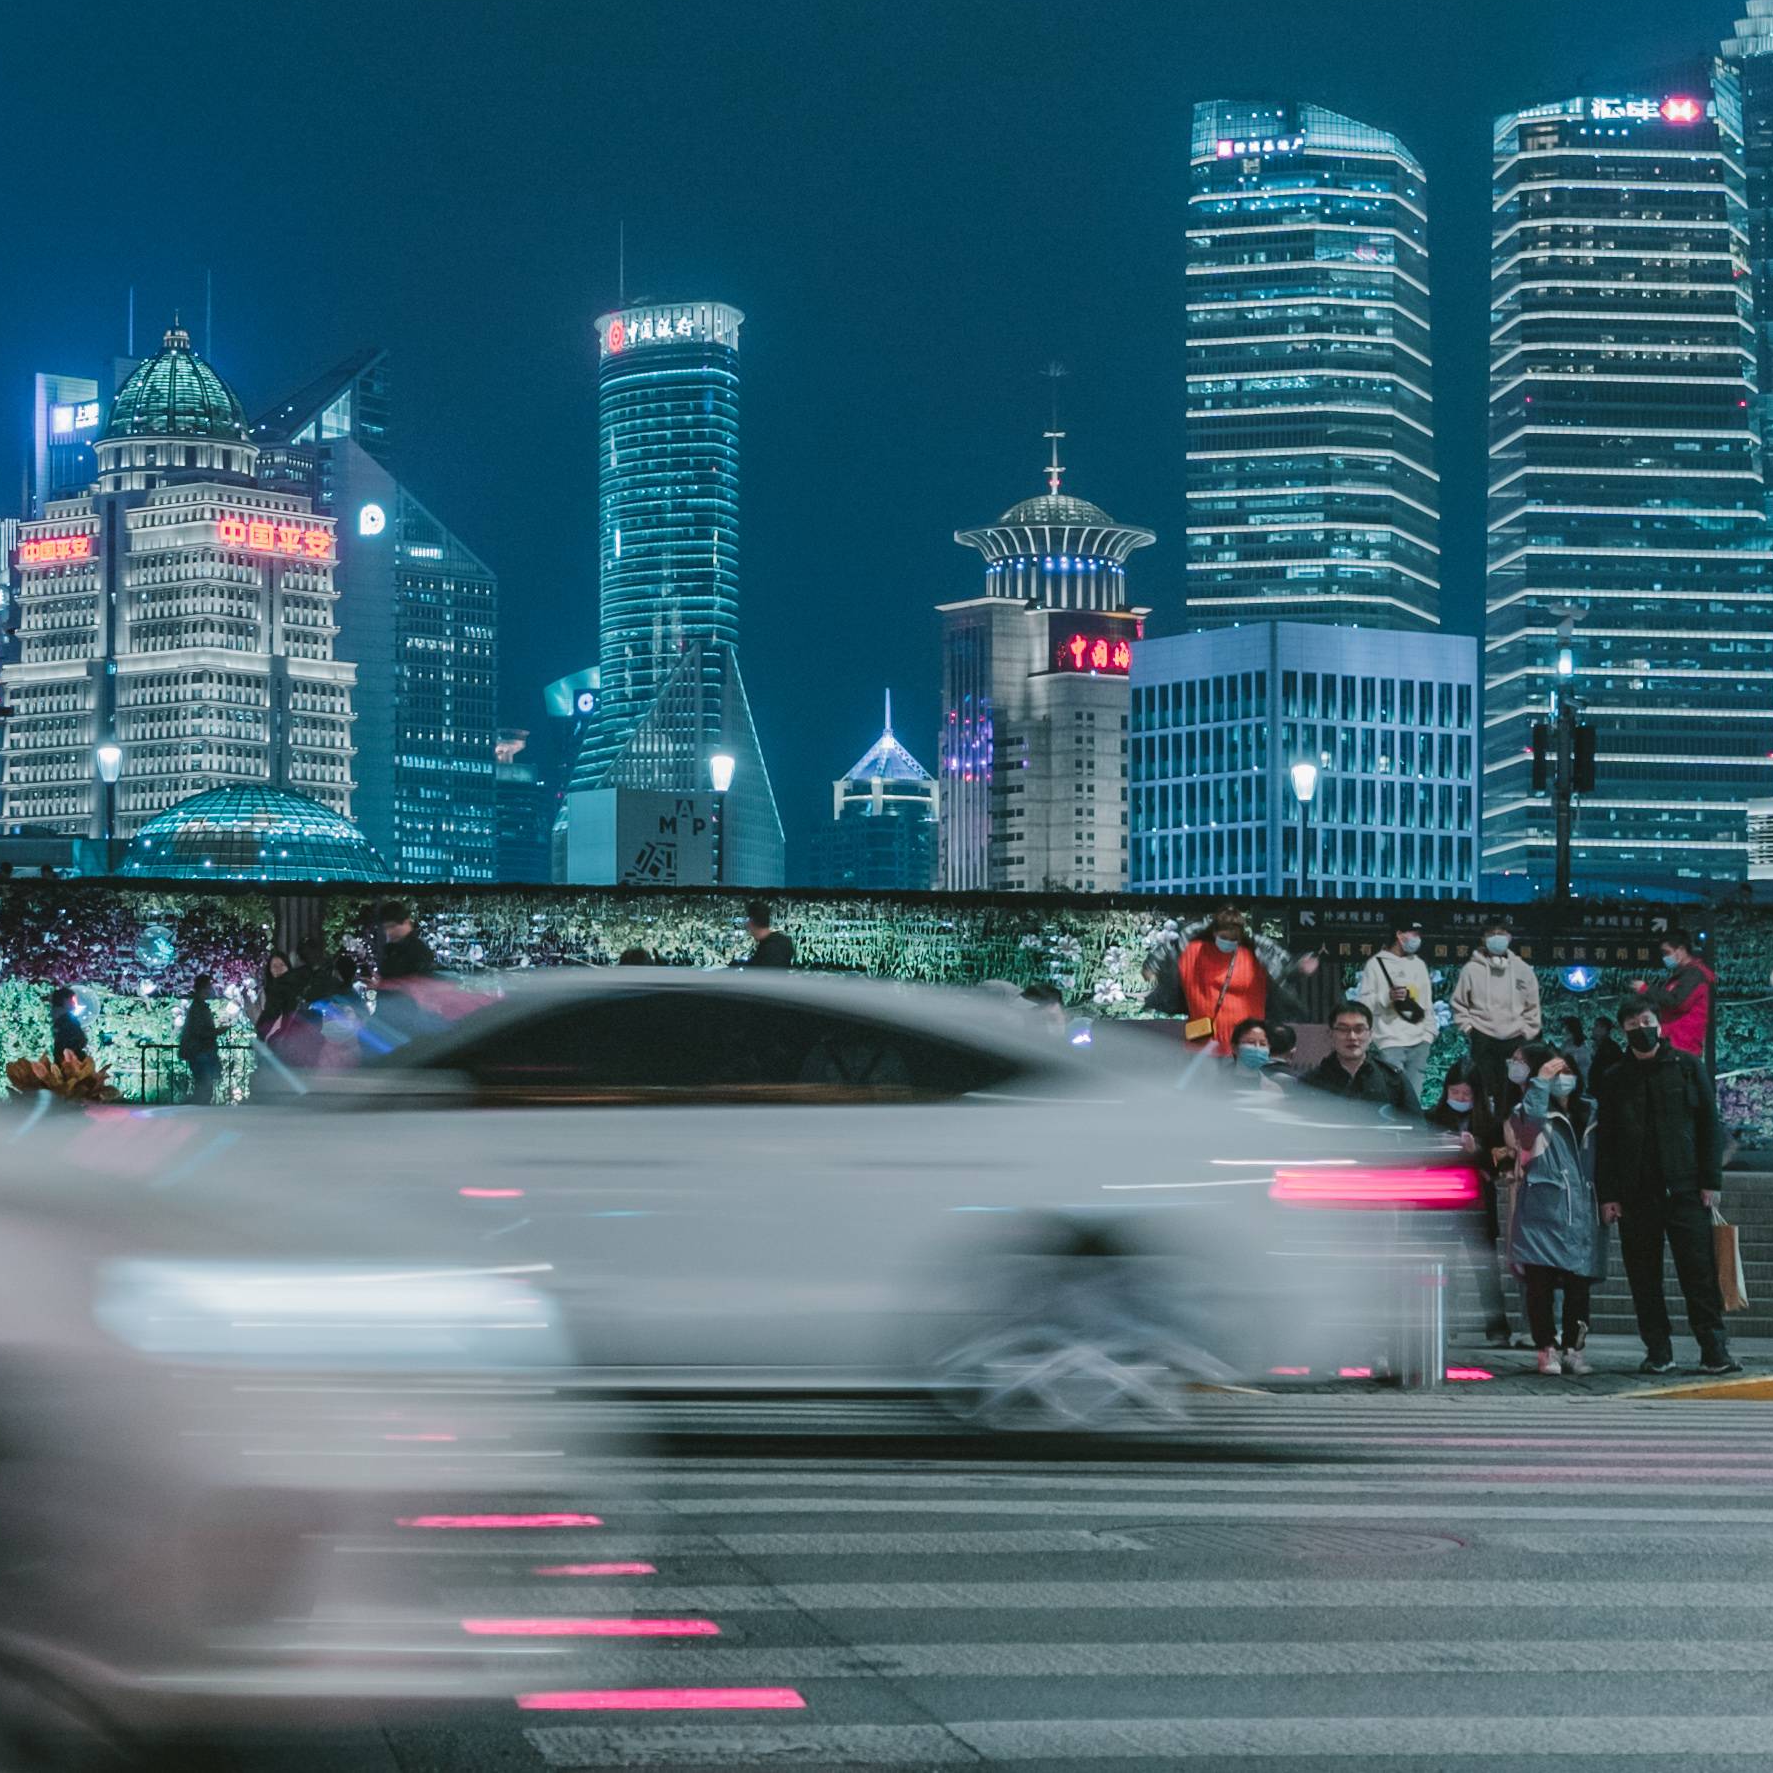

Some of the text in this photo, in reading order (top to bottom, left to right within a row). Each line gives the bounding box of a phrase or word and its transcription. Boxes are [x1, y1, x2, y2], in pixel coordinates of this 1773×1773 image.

[23, 536, 90, 563] 中国平安
[220, 519, 332, 558] 中国平安
